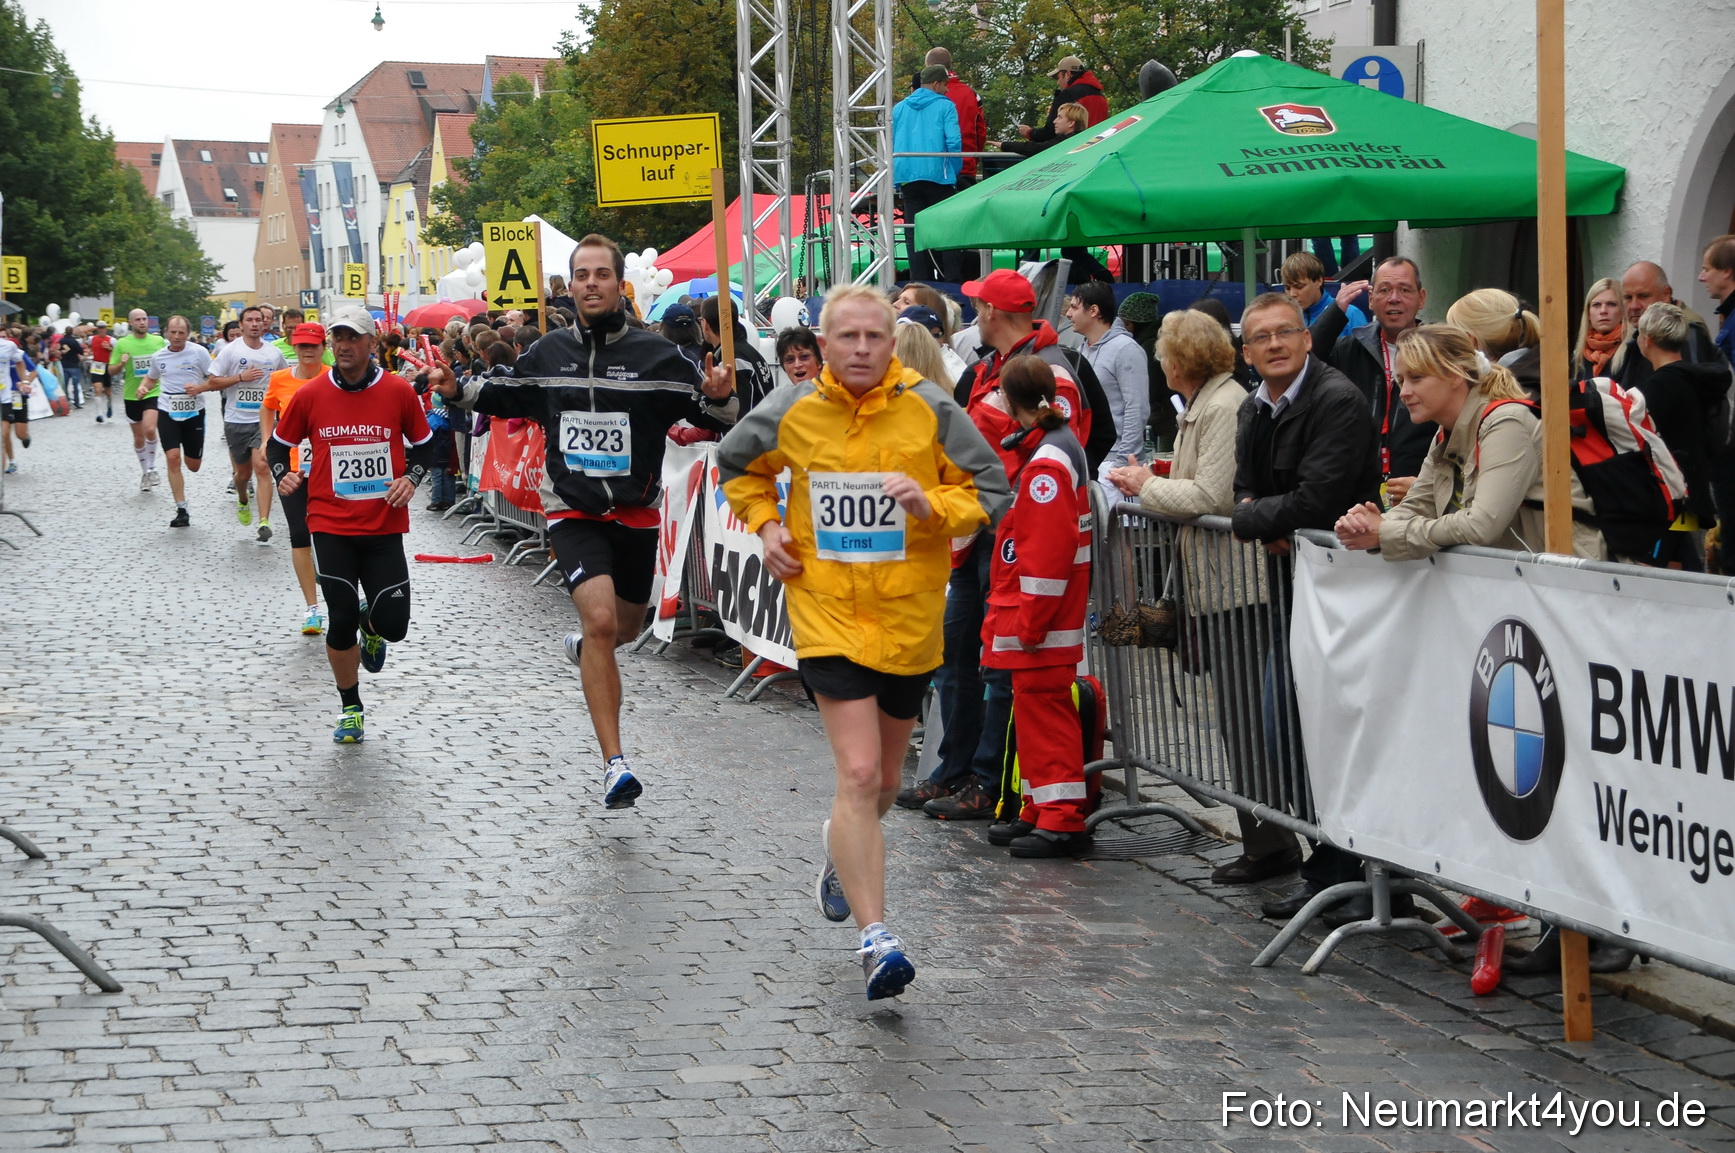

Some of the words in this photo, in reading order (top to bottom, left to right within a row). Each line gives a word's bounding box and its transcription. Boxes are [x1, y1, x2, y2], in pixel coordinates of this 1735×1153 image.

[603, 143, 710, 161] Schnupper-
[1239, 141, 1402, 159] Neumarkter
[641, 164, 675, 181] lauf
[1218, 154, 1447, 177] Lammsbräu
[490, 225, 534, 242] Block
[8, 267, 19, 284] B
[498, 249, 531, 291] A
[350, 274, 362, 291] B
[135, 360, 150, 369] 304
[238, 391, 264, 402] 2083
[171, 401, 196, 411] 3083
[562, 417, 582, 425] PARTL
[583, 418, 617, 426] Neumarkt
[319, 424, 382, 438] NEUMARKT
[567, 425, 624, 453] 2323
[303, 448, 312, 462] 2
[353, 448, 382, 456] Neumarkt
[338, 456, 387, 480] 2380
[353, 482, 376, 493] Erwin
[812, 481, 841, 490] PARTL
[842, 481, 884, 490] Neumark
[819, 494, 896, 527] 3002
[841, 536, 873, 549] Ernst
[1475, 624, 1555, 702] BMW
[1588, 662, 1735, 781] BMW
[1594, 780, 1735, 884] Wenige
